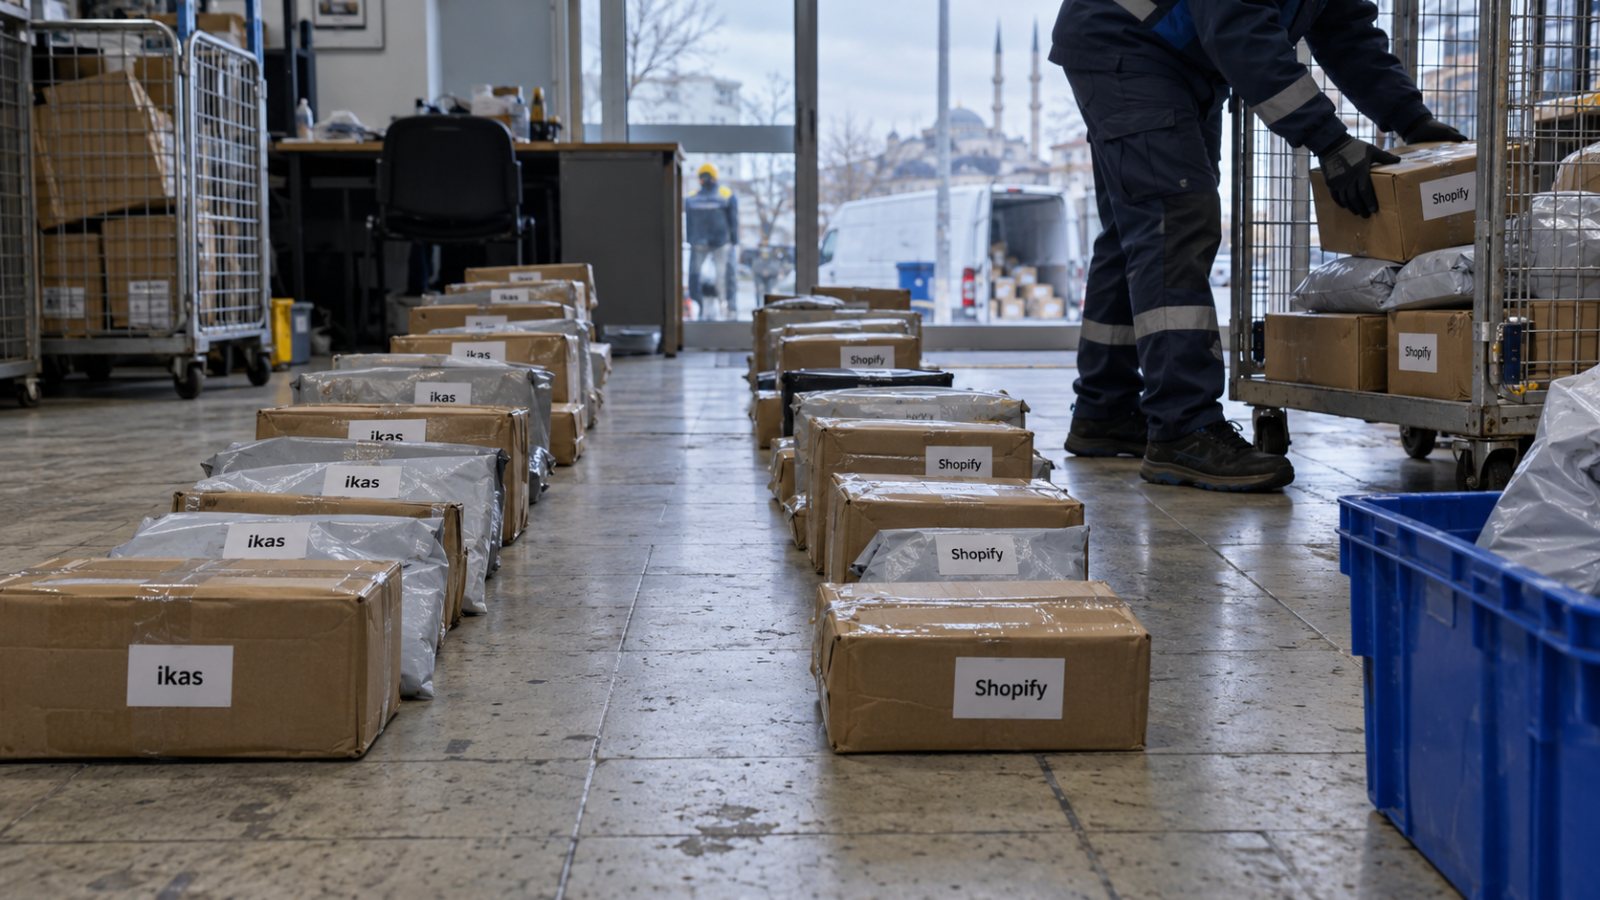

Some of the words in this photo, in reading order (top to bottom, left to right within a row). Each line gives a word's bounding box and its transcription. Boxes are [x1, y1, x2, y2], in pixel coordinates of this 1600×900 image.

[1432, 187, 1470, 205] Shopify
[850, 354, 886, 366] Shopify
[1405, 345, 1432, 361] Shopify
[430, 391, 456, 403] ikas
[370, 430, 403, 442] ikas
[938, 458, 982, 472] Shopify
[344, 475, 380, 489] ikas
[247, 534, 285, 549] ikas
[951, 547, 1004, 562] Shopify
[157, 665, 204, 686] ikas
[974, 678, 1048, 701] Shopify
